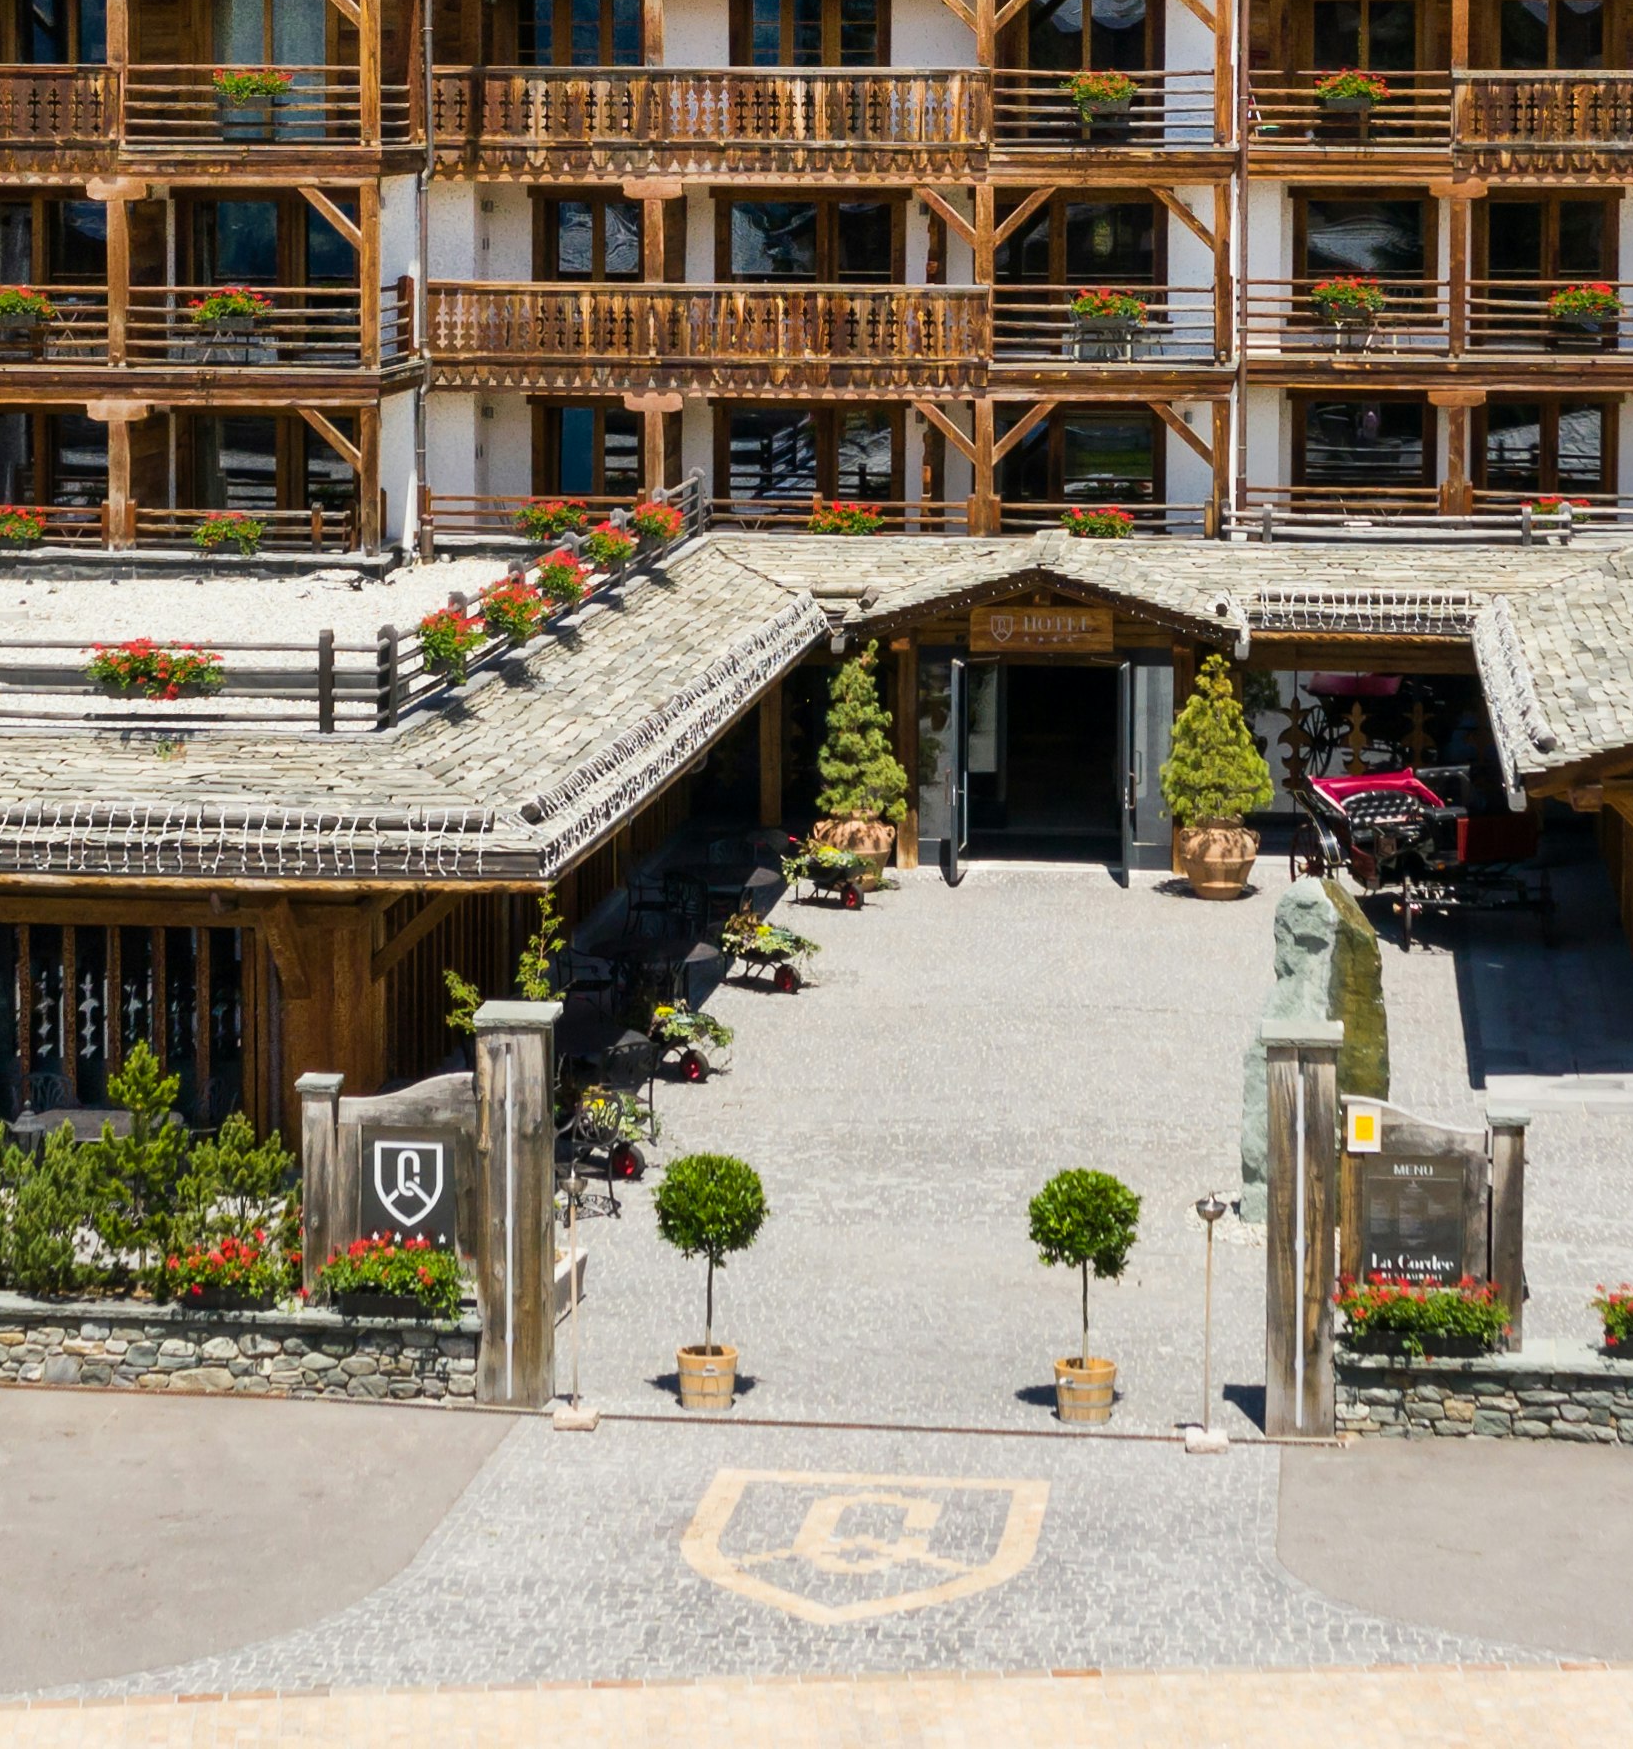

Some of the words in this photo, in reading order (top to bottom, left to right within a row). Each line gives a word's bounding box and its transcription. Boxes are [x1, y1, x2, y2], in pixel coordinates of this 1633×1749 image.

[1023, 616, 1093, 631] HOTEL
[1393, 1164, 1433, 1177] MENU
[1372, 1252, 1392, 1269] La
